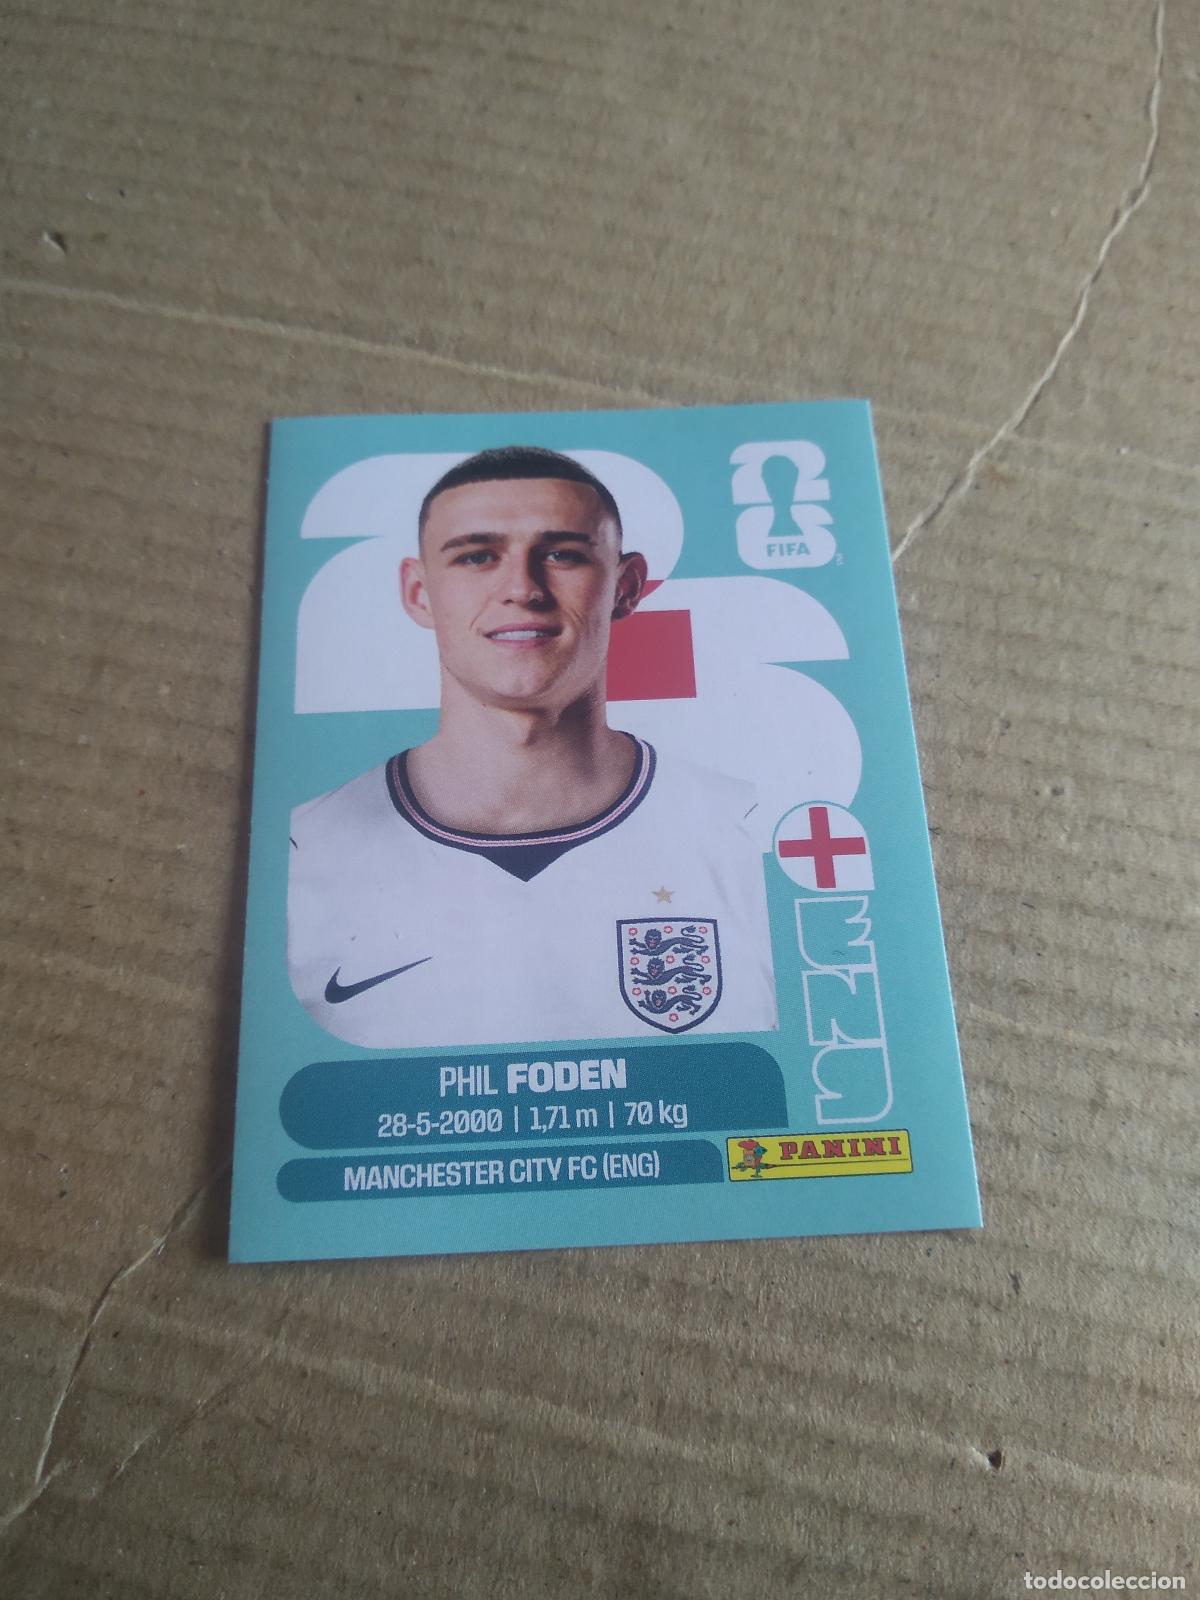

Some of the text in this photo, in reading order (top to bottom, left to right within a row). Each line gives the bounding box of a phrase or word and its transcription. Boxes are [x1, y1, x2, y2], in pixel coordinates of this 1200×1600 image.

[766, 542, 810, 557] FIFA
[439, 1058, 627, 1098] PHIL FODEN
[377, 1108, 503, 1138] 28-5-2000
[529, 1105, 571, 1133] 1,71
[575, 1107, 598, 1128] m
[624, 1101, 653, 1126] 70
[658, 1100, 688, 1128] kg
[779, 1136, 902, 1160] PANINI
[344, 1150, 660, 1191] MANCHESTER CITY FC (ENG)
